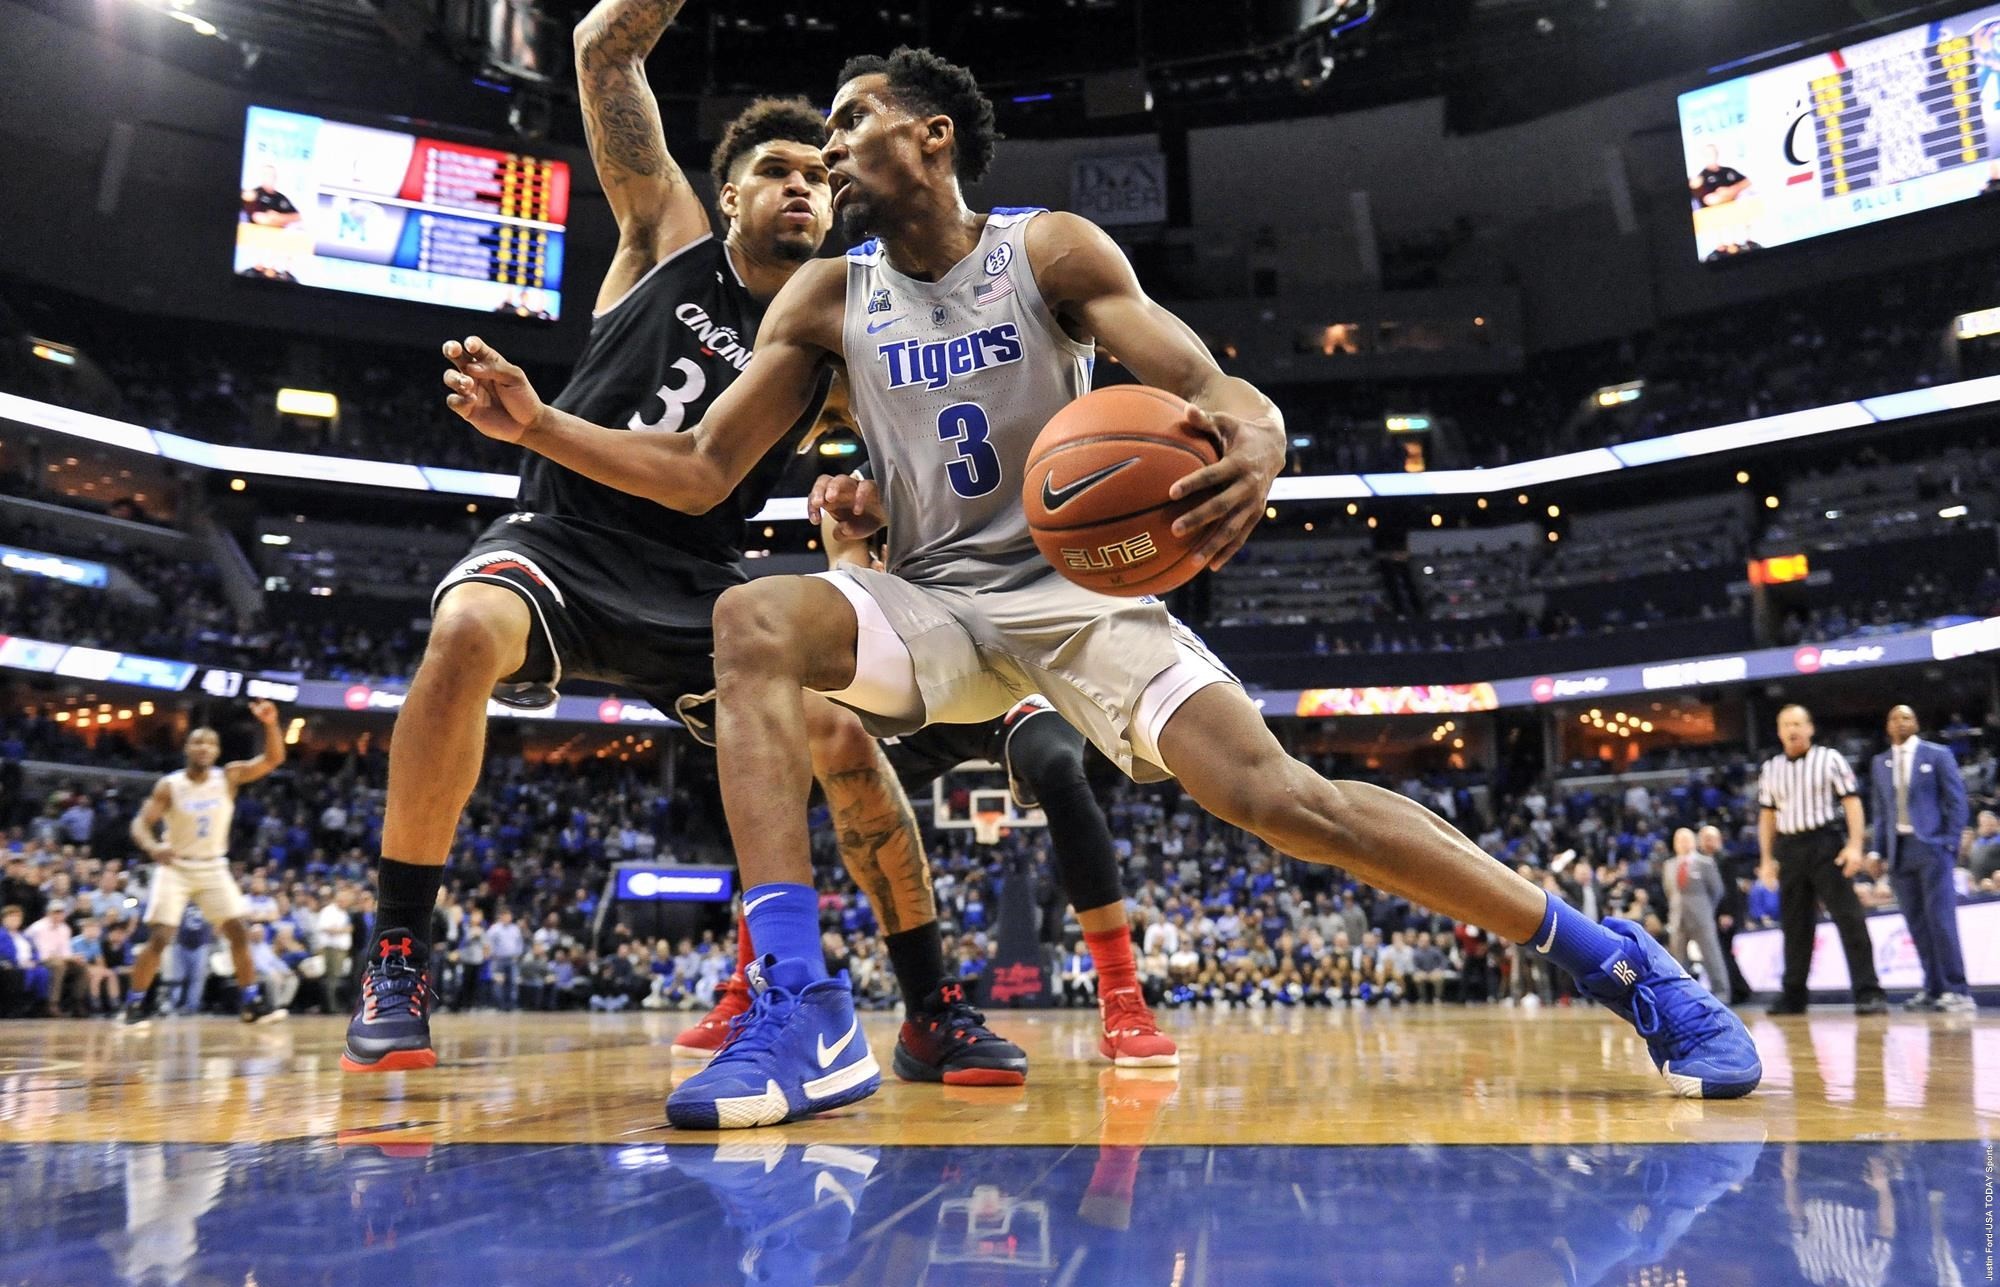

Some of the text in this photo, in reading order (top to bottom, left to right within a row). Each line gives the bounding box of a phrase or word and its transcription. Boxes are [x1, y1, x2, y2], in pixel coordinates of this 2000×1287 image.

[989, 247, 1004, 263] KA
[991, 255, 1006, 272] 23
[877, 322, 1024, 392] Tigers
[627, 357, 706, 433] 3
[936, 402, 1001, 499] 3
[1060, 531, 1158, 570] ELITE
